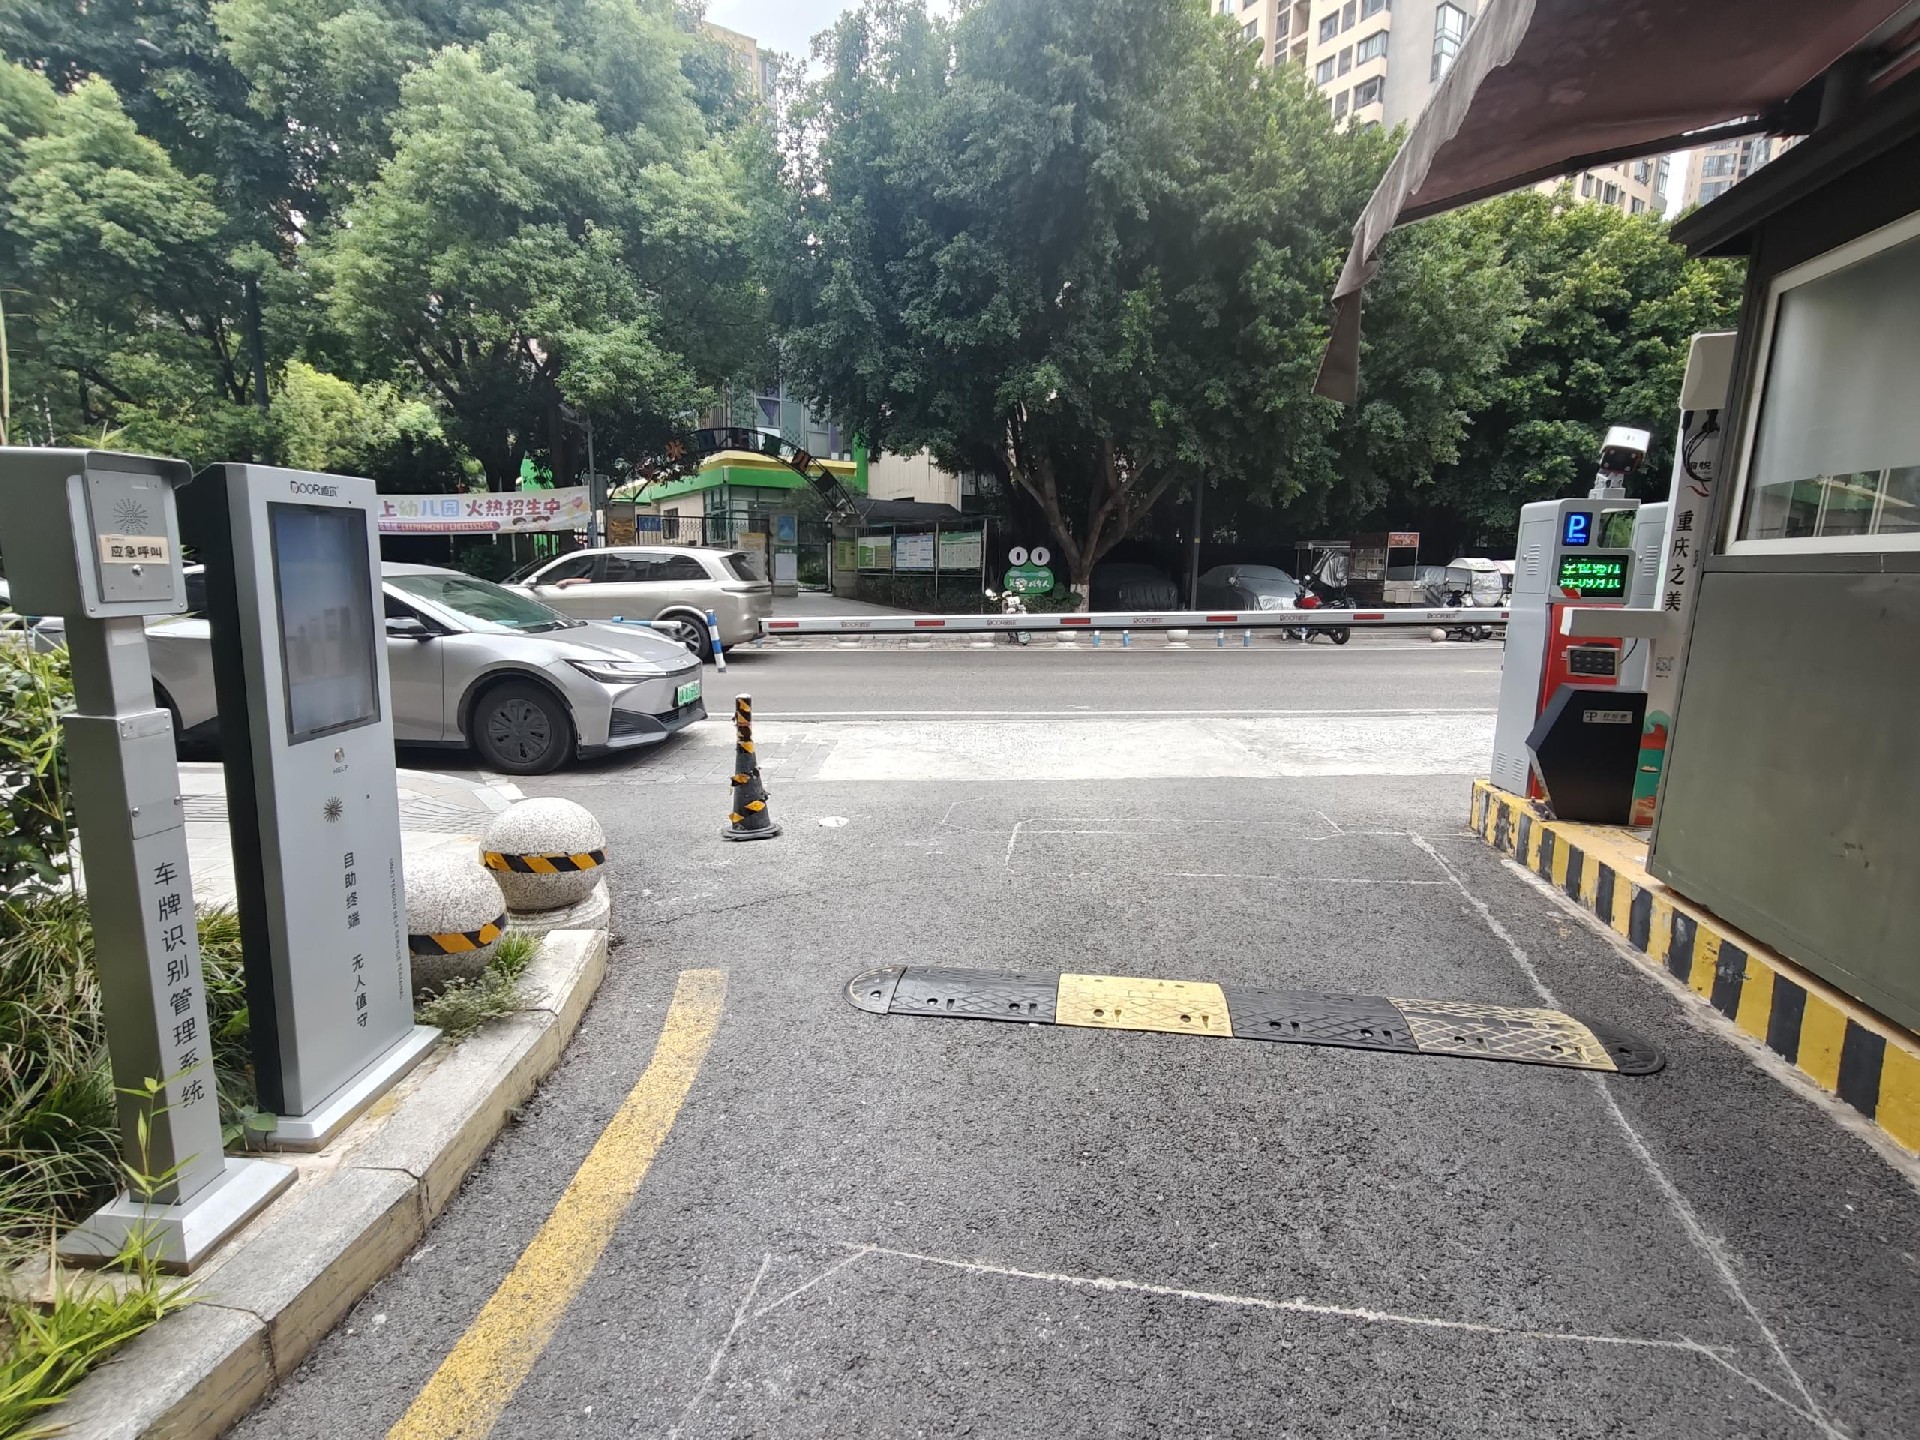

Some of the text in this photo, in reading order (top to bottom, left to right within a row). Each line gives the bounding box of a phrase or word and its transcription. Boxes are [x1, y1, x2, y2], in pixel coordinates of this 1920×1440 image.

[110, 545, 162, 559] 应急呼叫
[379, 497, 561, 517] 上幼儿园 火热招生中
[1665, 509, 1694, 612] 重庆之美
[154, 862, 205, 1109] 车牌识别管理系统
[343, 852, 368, 1028] 自助终端 无人值守
